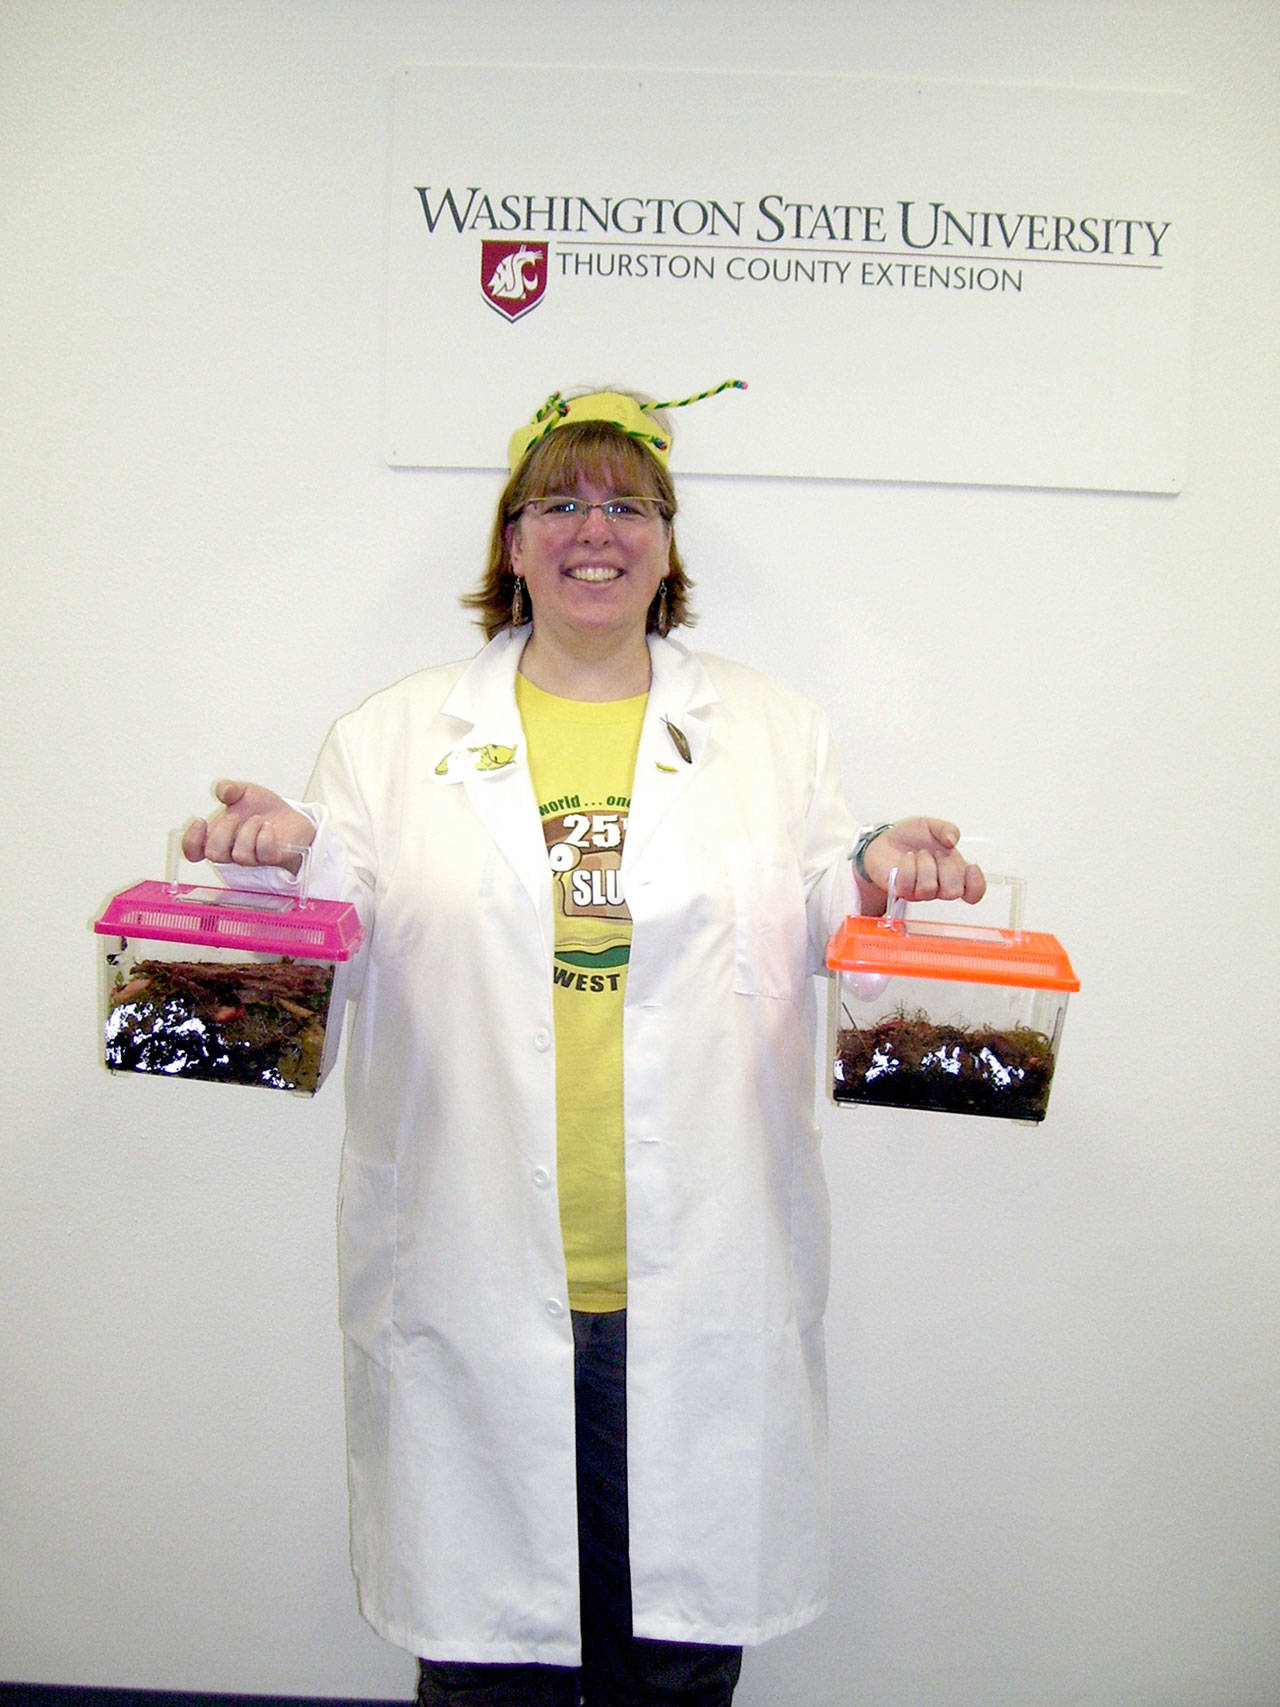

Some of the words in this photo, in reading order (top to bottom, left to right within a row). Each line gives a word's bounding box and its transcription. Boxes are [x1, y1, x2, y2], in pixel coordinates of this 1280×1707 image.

[413, 185, 745, 237] WASHINGTON
[755, 194, 888, 243] STATE
[896, 200, 1172, 258] UNIVERSITY
[555, 251, 716, 280] THURSTON
[725, 256, 852, 285] COUNTY
[860, 261, 1023, 293] EXTENSION
[553, 965, 621, 993] WEST
